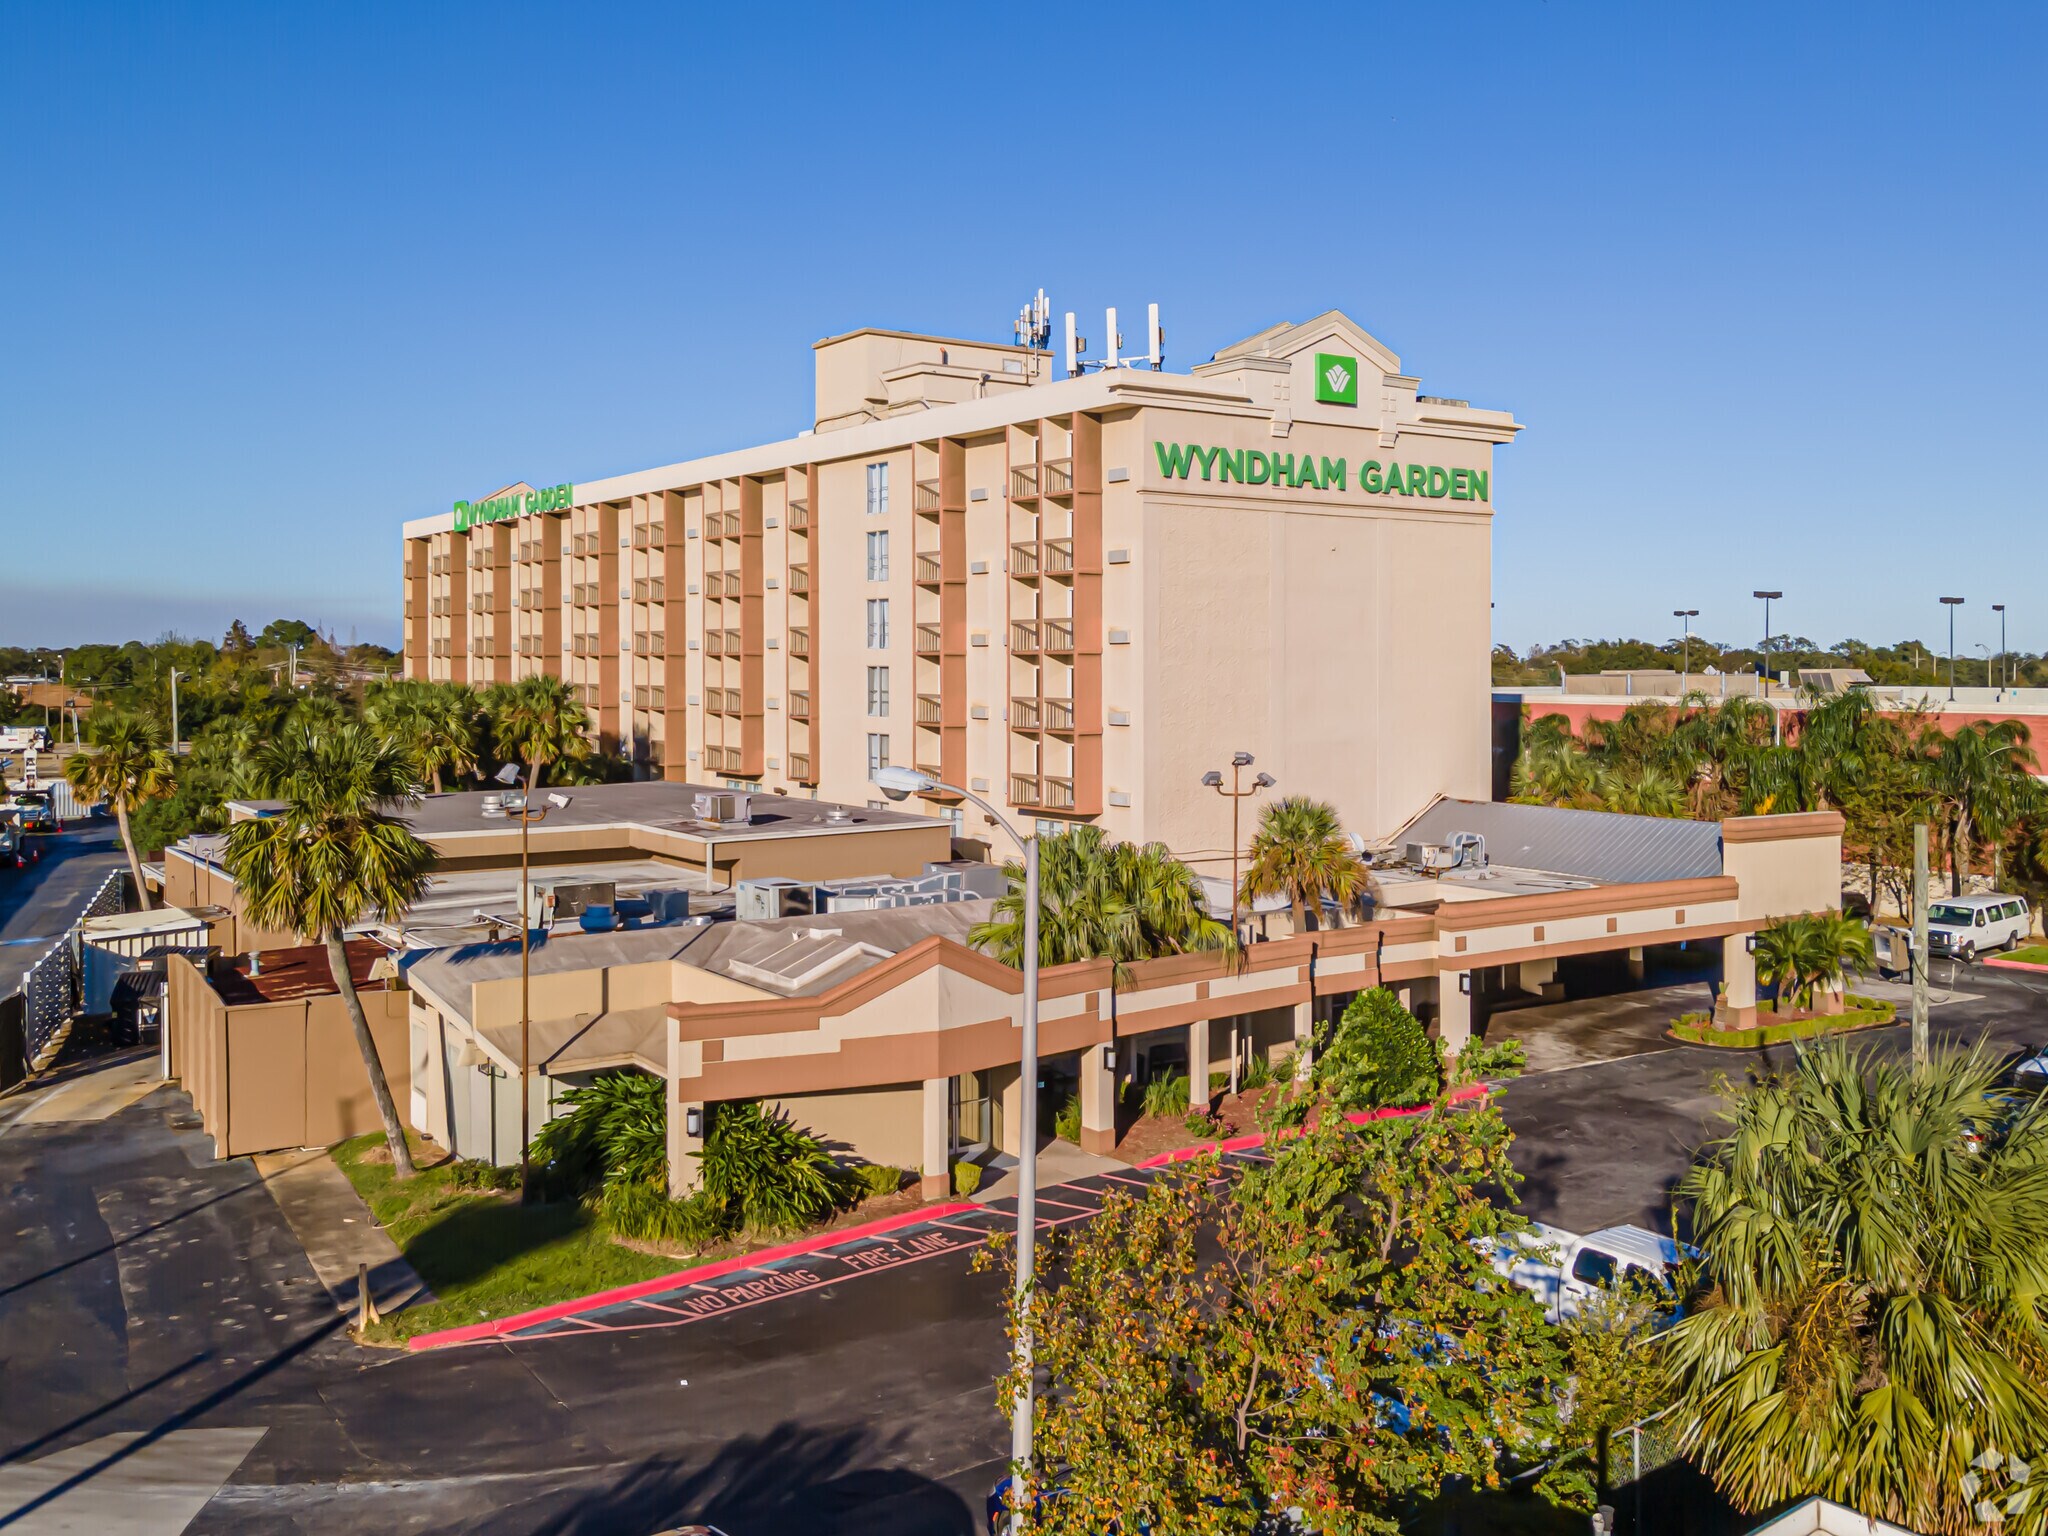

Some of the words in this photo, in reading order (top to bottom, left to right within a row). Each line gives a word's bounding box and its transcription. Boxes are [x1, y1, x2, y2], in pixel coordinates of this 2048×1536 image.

[525, 482, 573, 515] GARDEN
[1154, 441, 1347, 490] WYNDHAM
[1359, 460, 1489, 501] GARDEN
[684, 1294, 727, 1313] NO
[720, 1269, 821, 1301] PARKING
[841, 1247, 901, 1271] FIRE
[896, 1232, 959, 1257] LANE
